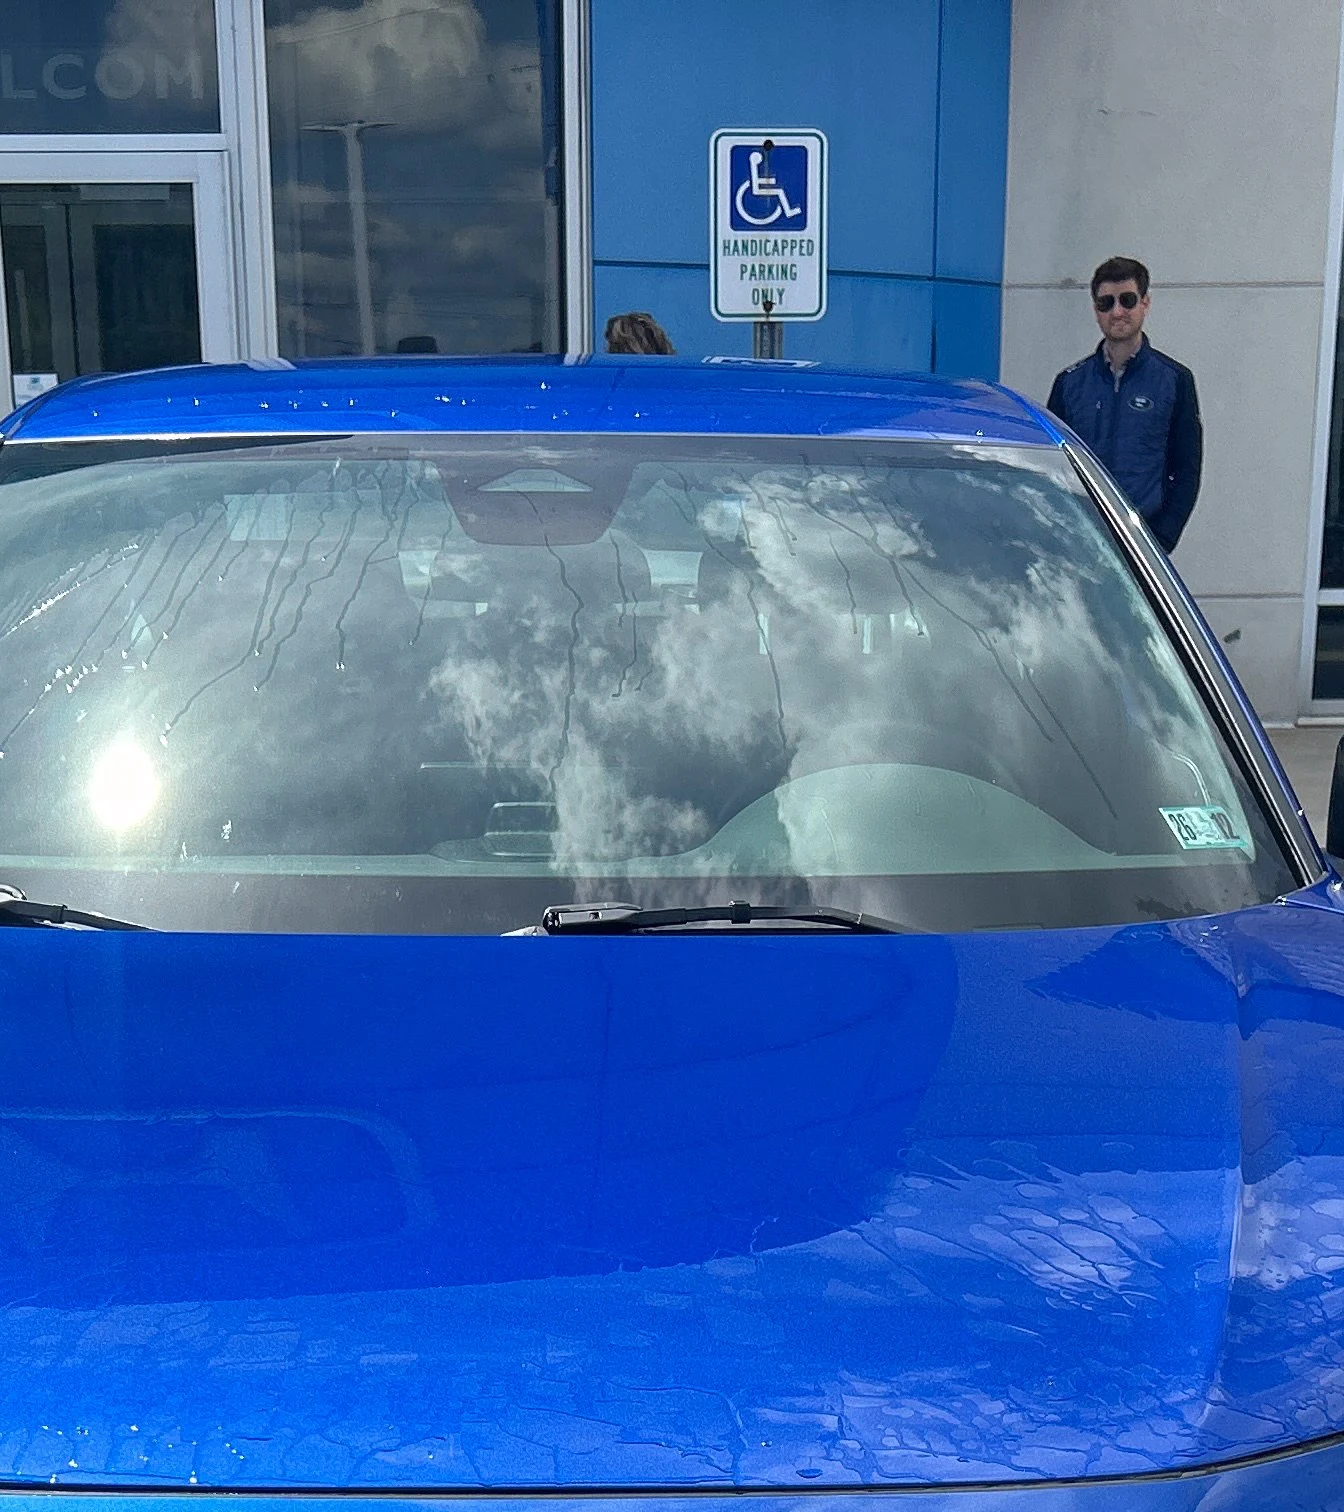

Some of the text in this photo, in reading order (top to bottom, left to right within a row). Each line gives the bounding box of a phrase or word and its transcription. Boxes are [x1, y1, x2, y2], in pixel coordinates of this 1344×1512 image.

[722, 239, 814, 256] HANDICAPPED
[740, 264, 797, 281] PARKING
[752, 288, 785, 306] ONLY
